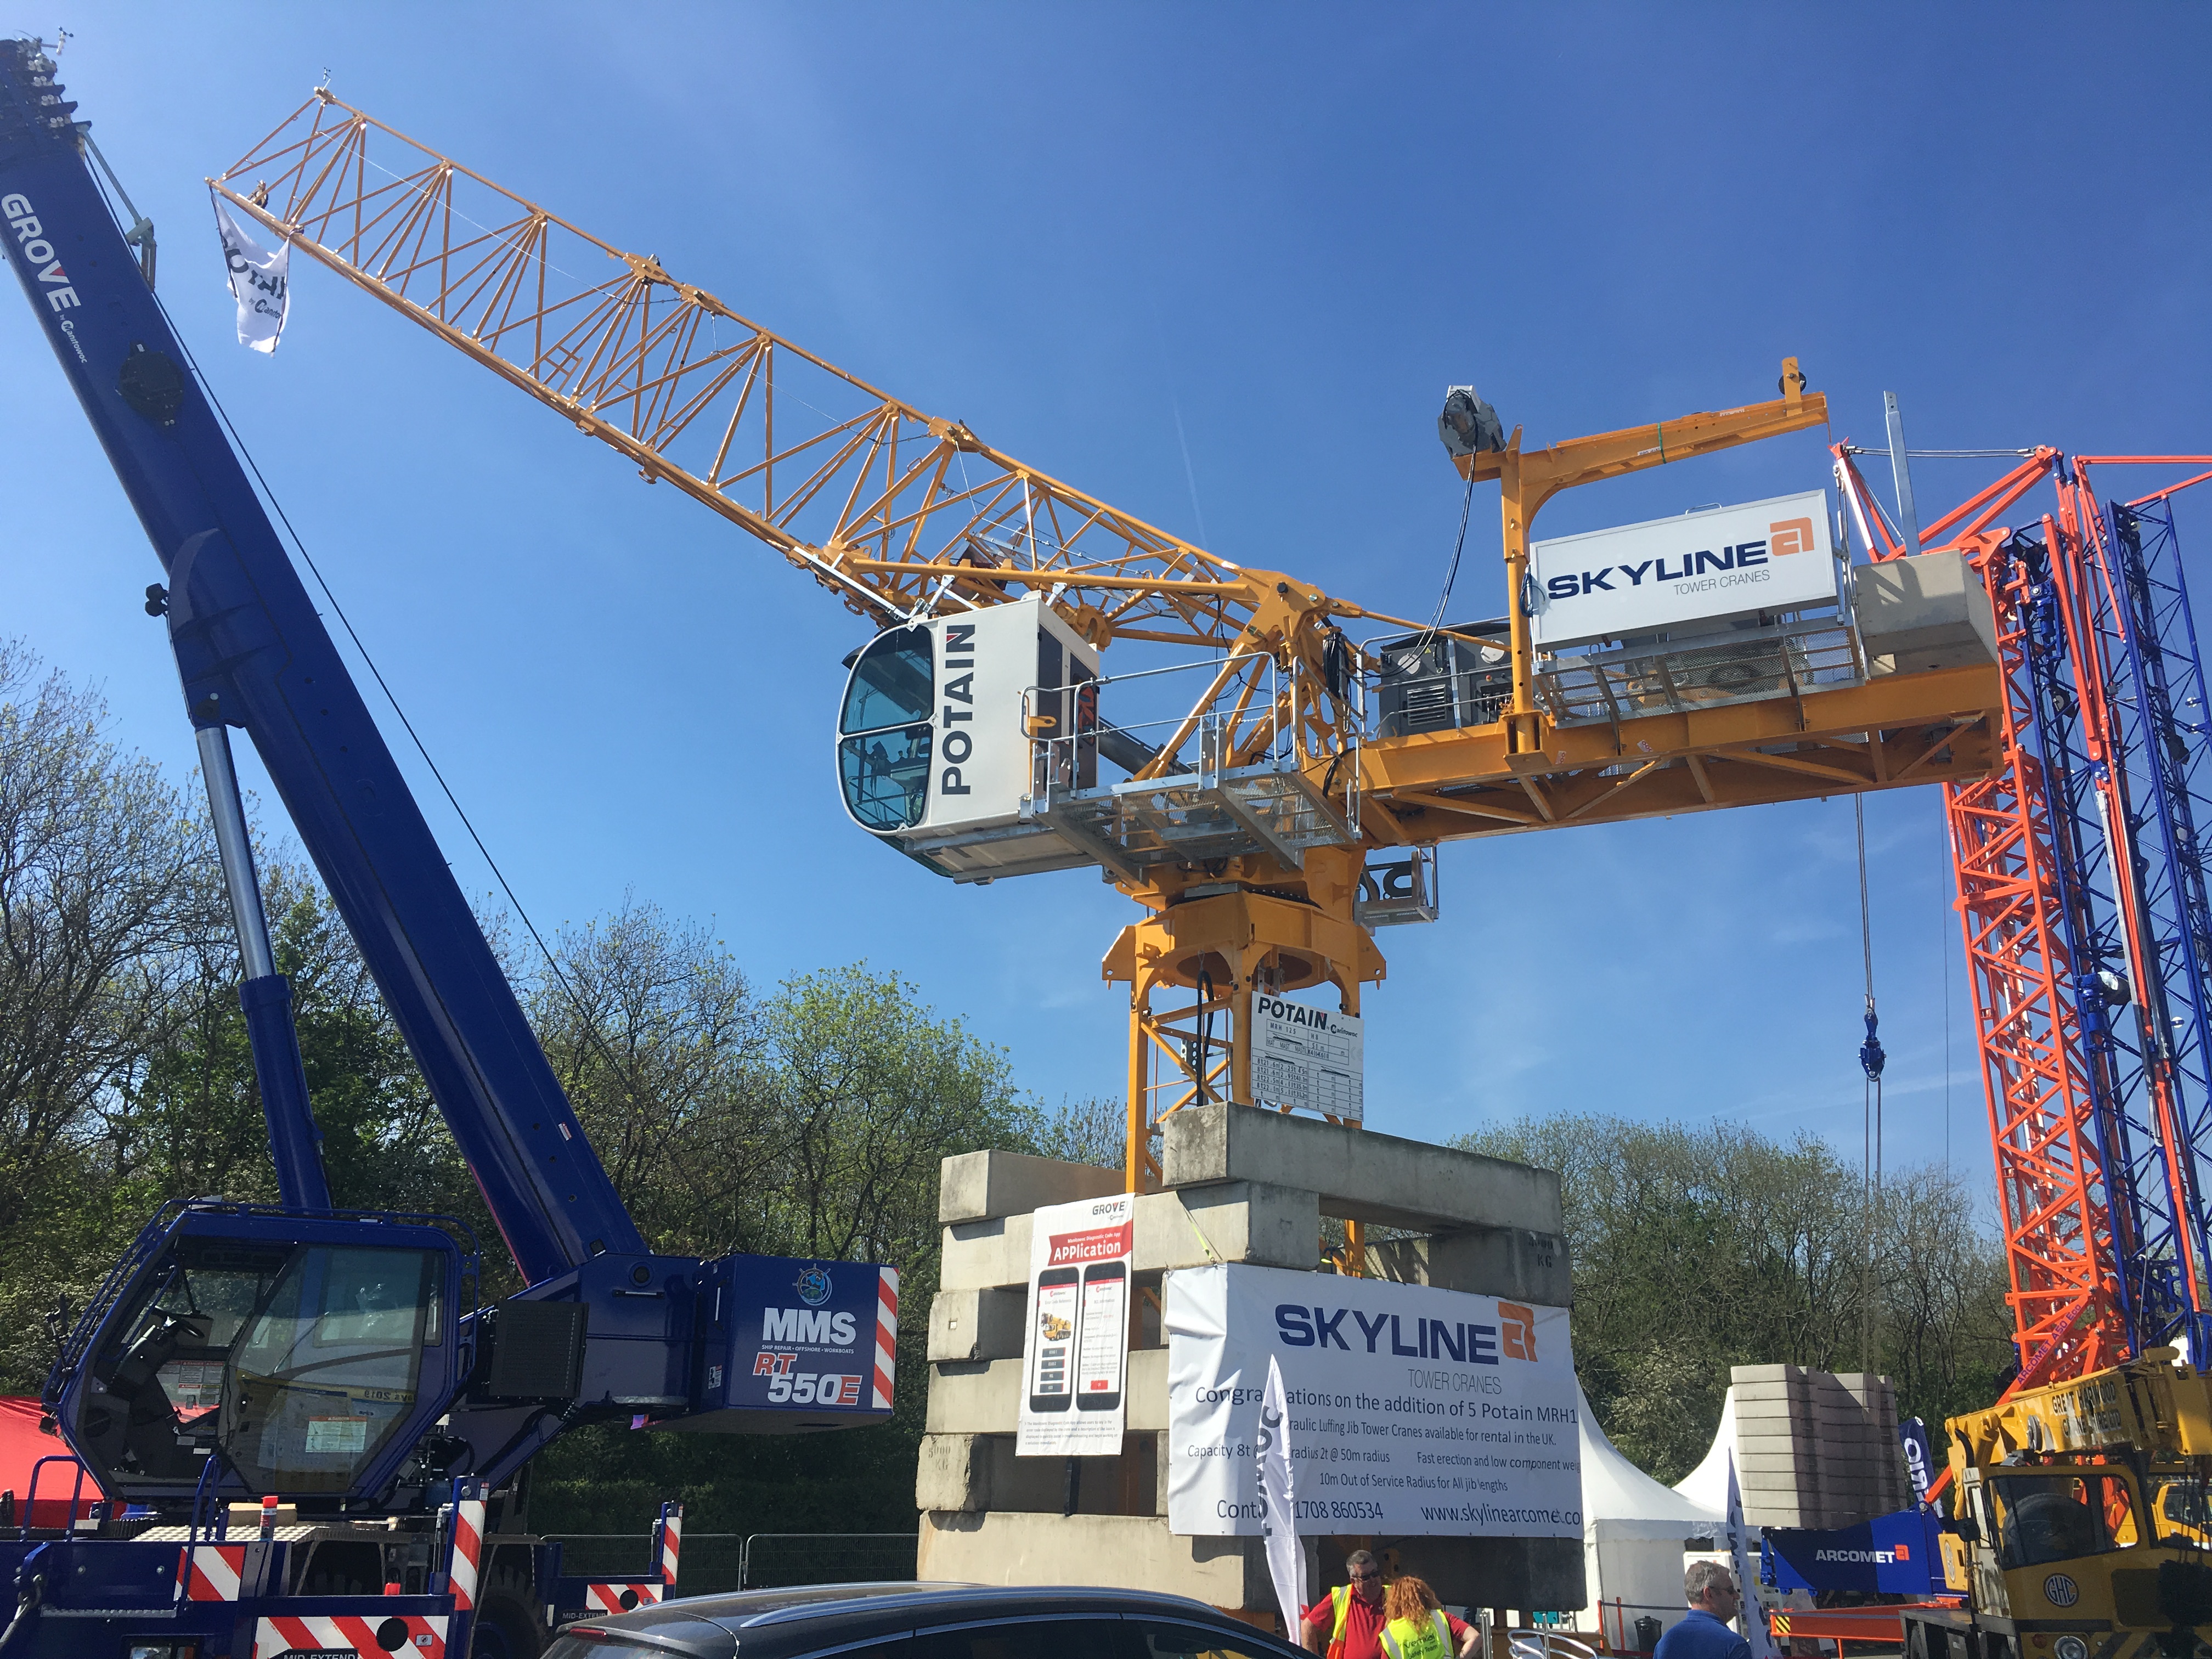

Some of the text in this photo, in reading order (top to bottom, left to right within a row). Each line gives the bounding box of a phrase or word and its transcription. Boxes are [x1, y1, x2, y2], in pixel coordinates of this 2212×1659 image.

[1, 194, 81, 312] GROVE
[61, 320, 87, 363] Manitowoc
[1548, 540, 1768, 600] SKYLINE
[1674, 569, 1770, 595] TOWER CRANES
[942, 624, 975, 794] POTAIN
[1258, 997, 1328, 1030] POTAIN
[1330, 1024, 1358, 1037] Manitowoc
[1270, 1023, 1282, 1031] MRH
[1092, 1201, 1125, 1215] GROVE
[763, 1307, 856, 1345] MMS
[1275, 1304, 1499, 1365] SKYLINE
[752, 1351, 798, 1376] RT
[2017, 1340, 2051, 1383] ARCOMET
[768, 1372, 862, 1406] 550E
[1408, 1369, 1502, 1395] TOWER CRANES
[1335, 1397, 1351, 1408] on
[1356, 1392, 1380, 1411] the
[1385, 1396, 1444, 1415] addition
[1449, 1400, 1464, 1417] of
[1469, 1402, 1476, 1417] 5
[1482, 1403, 1533, 1421] Potain
[1319, 1419, 1345, 1436] Luffing
[1347, 1421, 1359, 1434] Jib
[1362, 1422, 1389, 1436] Tower
[1392, 1424, 1422, 1438] Cranes
[1425, 1426, 1463, 1441] available
[1466, 1428, 1478, 1441] for
[1481, 1431, 1511, 1443] rental
[1514, 1431, 1523, 1444] in
[1526, 1432, 1540, 1444] the
[1542, 1433, 1557, 1446] UK.
[1188, 1445, 1233, 1460] Capacity
[1237, 1444, 1250, 1457] 8t
[1321, 1447, 1328, 1460] 2t
[1330, 1448, 1338, 1462] @
[1341, 1449, 1359, 1462] 50m
[1363, 1449, 1390, 1463] radius
[1417, 1452, 1434, 1464] Fast
[1437, 1454, 1472, 1466] erection
[1474, 1455, 1489, 1466] and
[1491, 1456, 1506, 1468] low
[1510, 1458, 1560, 1471] component
[1320, 1472, 1508, 1493] 10m Out of Service Radius for All jib lengths
[1295, 1501, 1328, 1519] 1708
[1333, 1501, 1384, 1520] 860534
[1815, 1549, 1895, 1563] ARCOMET
[2047, 1577, 2075, 1604] GHC
